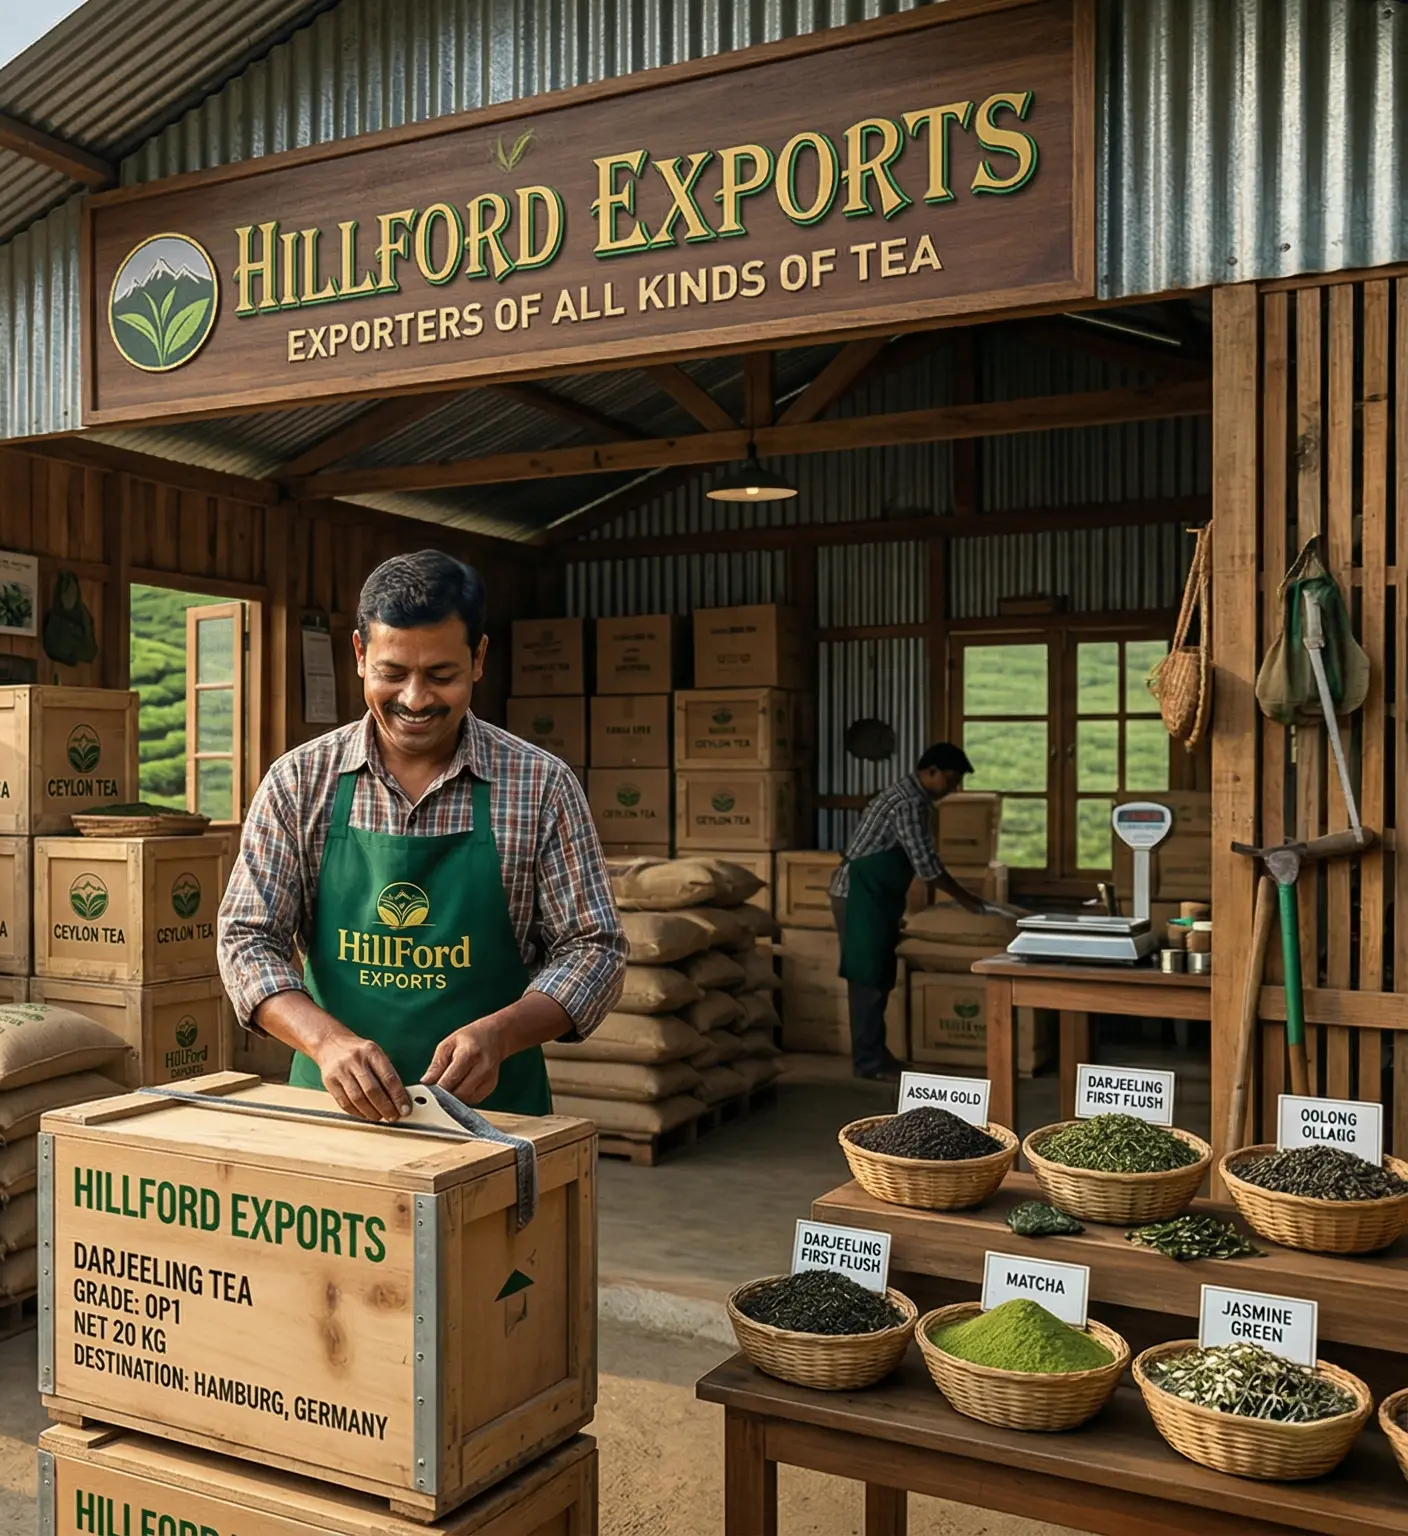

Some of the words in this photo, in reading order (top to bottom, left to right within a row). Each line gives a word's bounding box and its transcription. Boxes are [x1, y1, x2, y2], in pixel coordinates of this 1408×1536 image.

[233, 185, 565, 318] HILLFORD
[591, 90, 1039, 260] EXPORTS
[287, 302, 484, 363] EXPORTERS
[494, 293, 543, 332] OF
[552, 281, 625, 324] ALL
[638, 259, 767, 312] KINDS
[779, 247, 837, 292] OF
[849, 234, 944, 282] TEA
[47, 779, 93, 797] CEYLON
[95, 779, 118, 797] TEA
[53, 924, 99, 942] CEYLON
[102, 928, 126, 944] TEA
[157, 927, 194, 944] CEYLON
[196, 923, 214, 940] TEA
[337, 928, 472, 969] HillFord
[359, 969, 447, 989] EXPORTS
[906, 1085, 948, 1102] ASSAM
[950, 1090, 981, 1105] GOLD
[1088, 1075, 1163, 1094] DARJEELING
[1086, 1090, 1120, 1105] FIRST
[1123, 1093, 1163, 1110] FLUSH
[1300, 1108, 1357, 1126] OOLONG
[74, 1166, 221, 1233] HILLFORD
[231, 1192, 387, 1263] EXPORTS
[803, 1231, 882, 1256] DARJEELING
[801, 1247, 836, 1265] FIRST
[839, 1253, 881, 1273] FLUSH
[74, 1242, 204, 1296] DARJEELING
[209, 1268, 253, 1307] TEA
[1006, 1272, 1065, 1294] MATCHA
[73, 1278, 140, 1316] GRADE:
[145, 1293, 181, 1325] OP1
[1221, 1300, 1293, 1326] JASMINE
[74, 1310, 108, 1340] NET
[113, 1318, 136, 1347] 20
[142, 1325, 167, 1355] KG
[1231, 1320, 1283, 1343] GREEN
[74, 1343, 190, 1393] DESTINATION:
[194, 1371, 290, 1422] HAMBURG,
[294, 1395, 389, 1441] GERMANY
